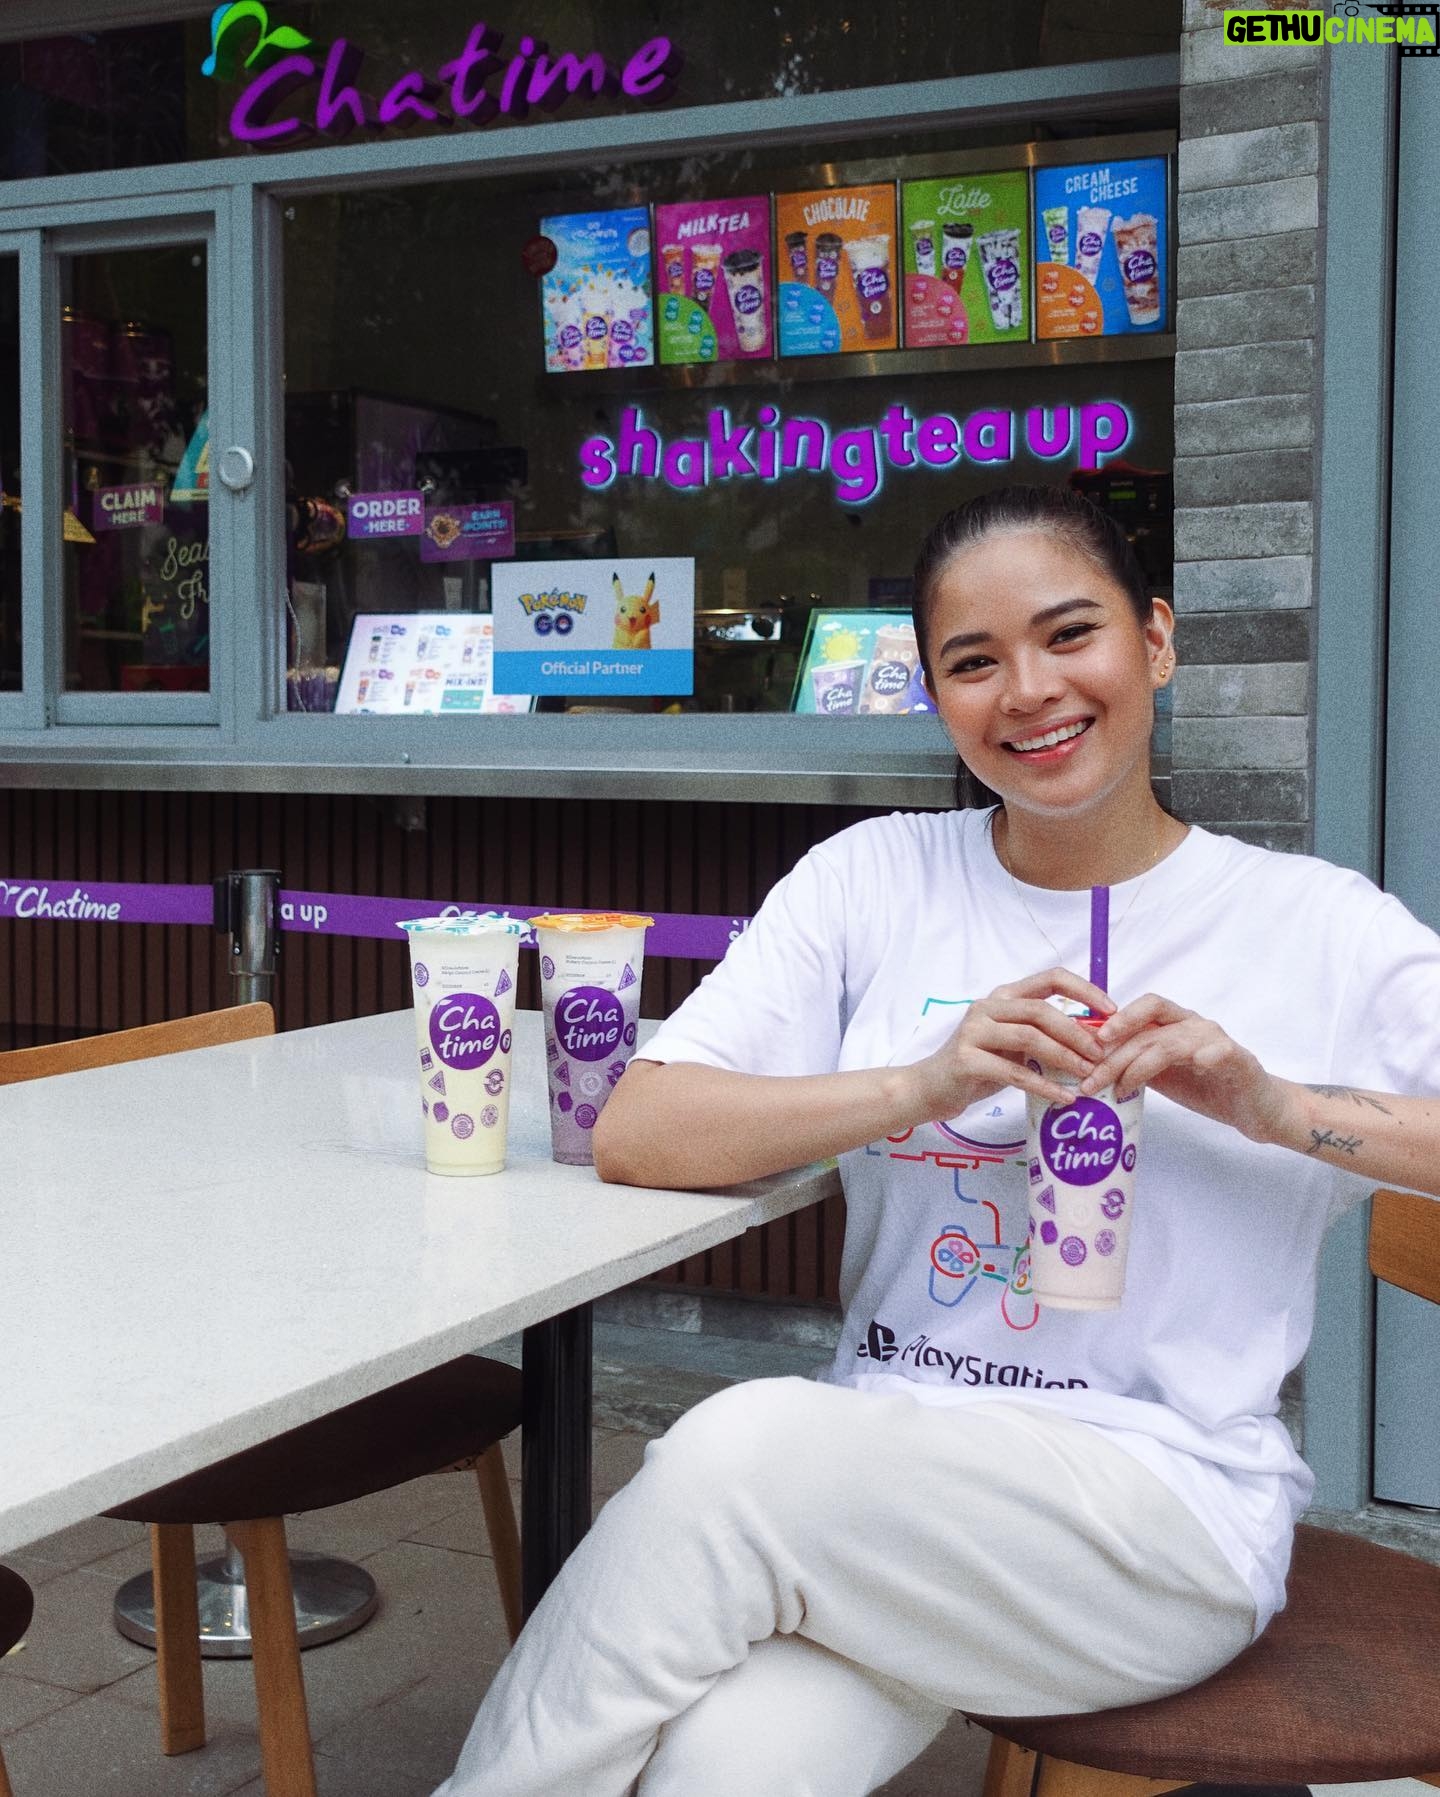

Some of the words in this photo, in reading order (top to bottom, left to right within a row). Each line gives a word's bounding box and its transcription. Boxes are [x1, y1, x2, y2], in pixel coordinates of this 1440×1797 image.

[229, 21, 672, 142] Chatime
[1065, 168, 1111, 194] CREAM
[1090, 177, 1139, 204] CHEESE
[803, 196, 871, 227] CHOCOLATE
[937, 184, 992, 216] Latte
[1128, 254, 1155, 269] Cha
[1027, 401, 1132, 470] up
[101, 488, 156, 511] CLAIM
[352, 498, 421, 519] ORDER
[112, 510, 145, 525] HERE
[368, 518, 406, 534] HERE
[534, 613, 574, 636] GO
[541, 661, 590, 675] Official
[593, 661, 644, 675] Partner
[878, 665, 908, 680] Cha
[826, 687, 853, 701] Cha
[874, 678, 905, 691] time
[826, 697, 853, 712] time
[15, 886, 121, 920] Chatime
[300, 904, 328, 929] up
[438, 1005, 496, 1032] Cha
[564, 998, 619, 1024] Cha
[439, 1033, 495, 1059] time
[564, 1025, 618, 1050] time
[1050, 1110, 1117, 1141] Cha
[1050, 1145, 1115, 1172] time
